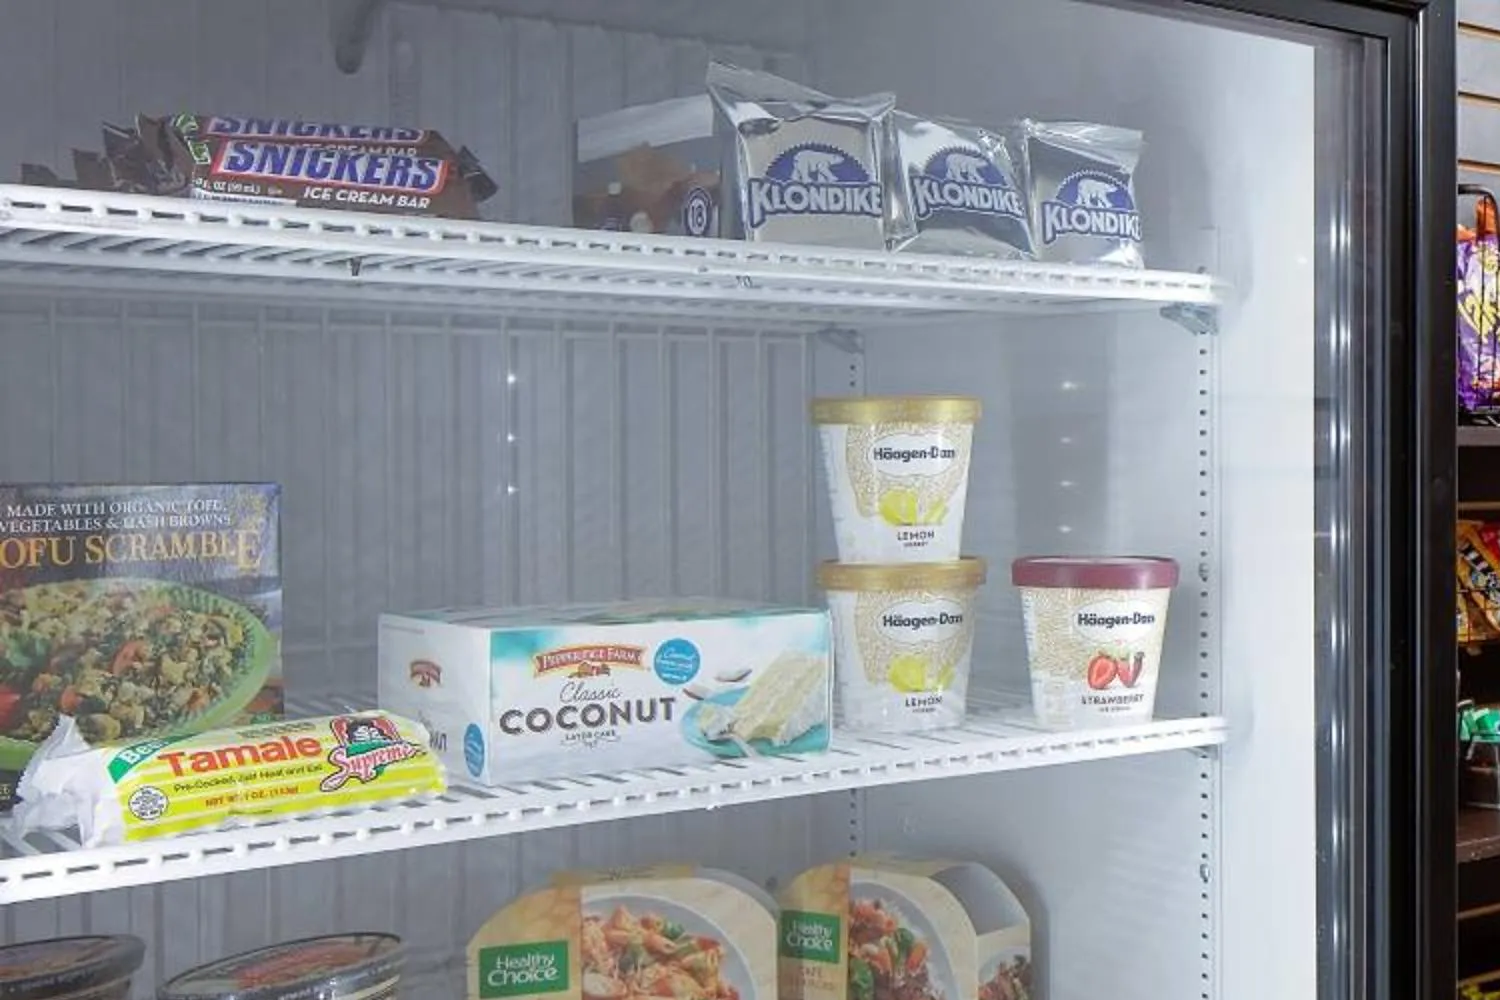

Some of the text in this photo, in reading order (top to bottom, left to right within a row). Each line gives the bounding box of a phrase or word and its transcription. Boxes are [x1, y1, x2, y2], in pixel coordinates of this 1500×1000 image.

[226, 138, 441, 191] SNICKERS
[303, 185, 431, 209] ICE CREAM BAR
[748, 177, 883, 228] KLONDIKE
[912, 176, 1025, 220] KLONDIKE
[7, 503, 57, 518] MADE
[60, 502, 105, 517] WITH
[109, 500, 181, 515] ORGANIC
[0, 528, 262, 570] OFU SCRAMBLE
[606, 645, 642, 666] FARM
[559, 681, 622, 704] Classic
[499, 697, 676, 736] COCONUT
[157, 736, 323, 778] Tamale
[487, 967, 561, 987] Choice
[495, 952, 555, 971] Healthy
